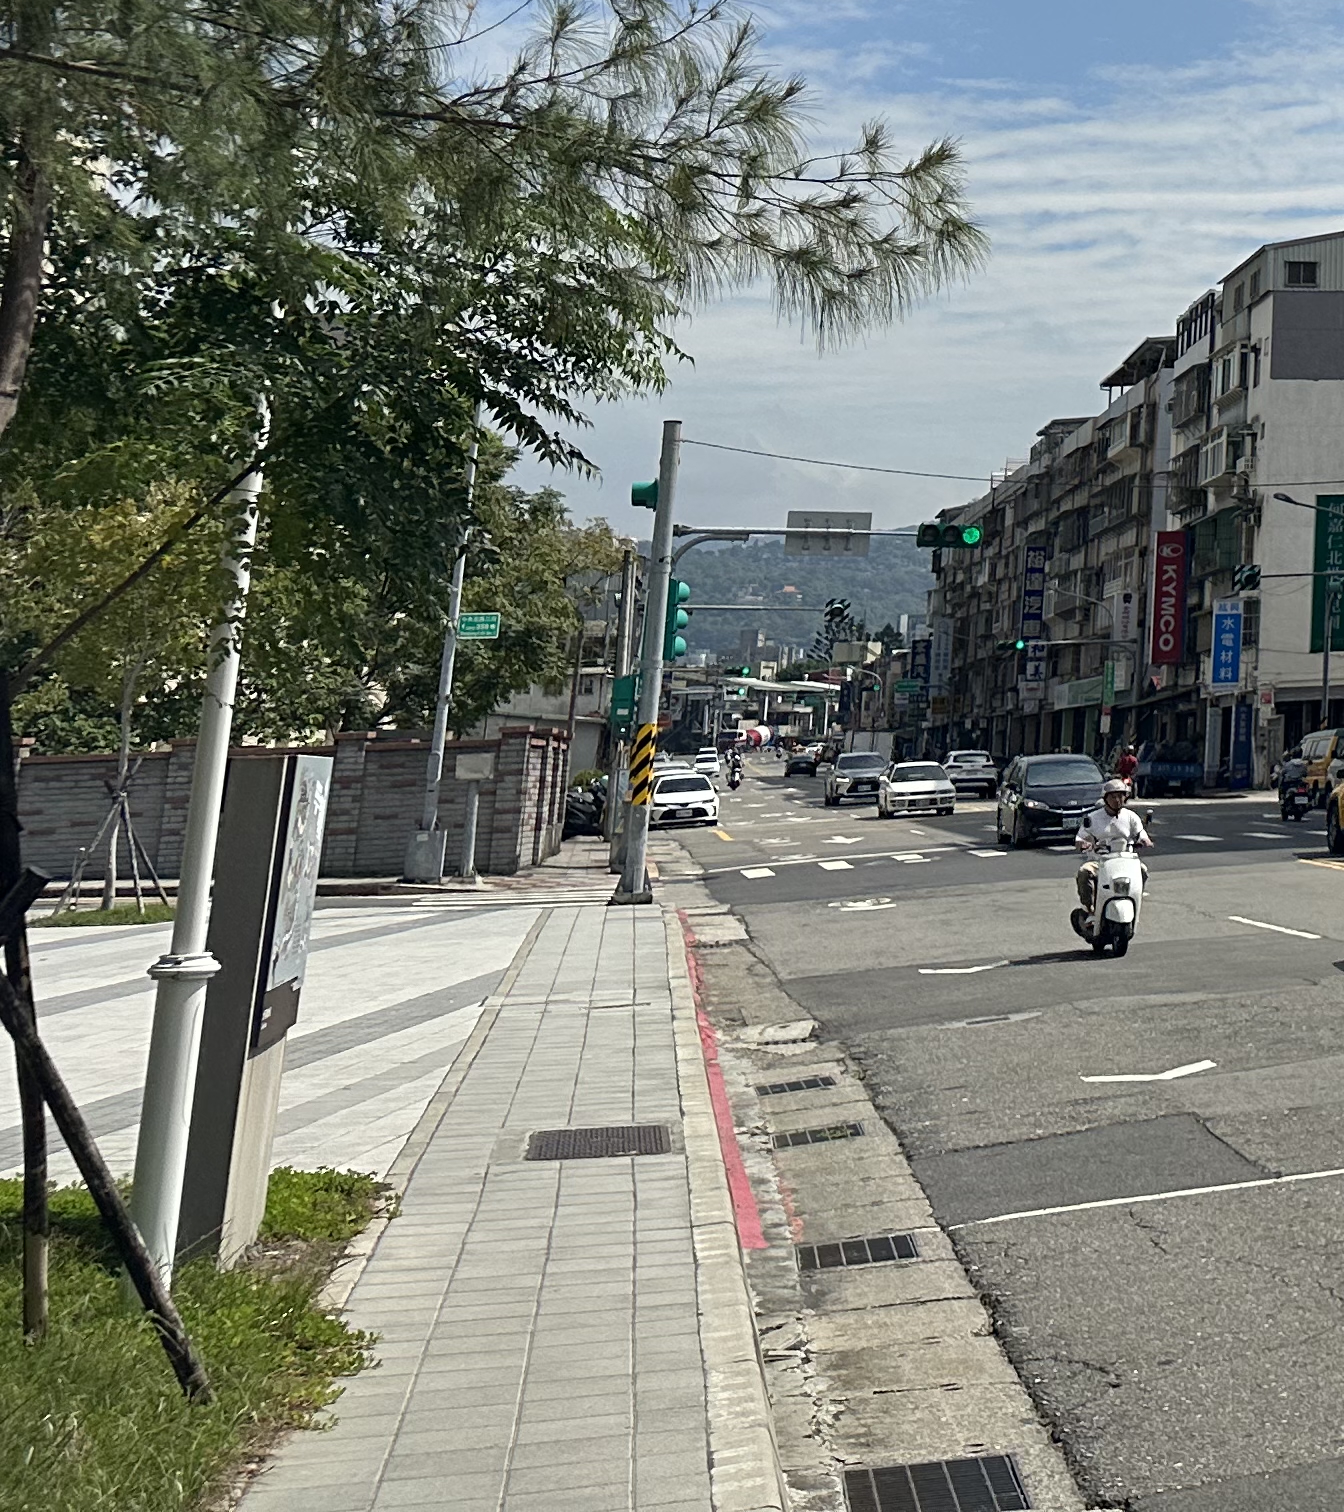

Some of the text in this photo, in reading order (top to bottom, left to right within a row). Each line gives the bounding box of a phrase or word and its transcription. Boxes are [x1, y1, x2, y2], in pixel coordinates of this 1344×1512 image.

[1158, 564, 1178, 652] KYMCO
[1218, 616, 1236, 681] 水電材料
